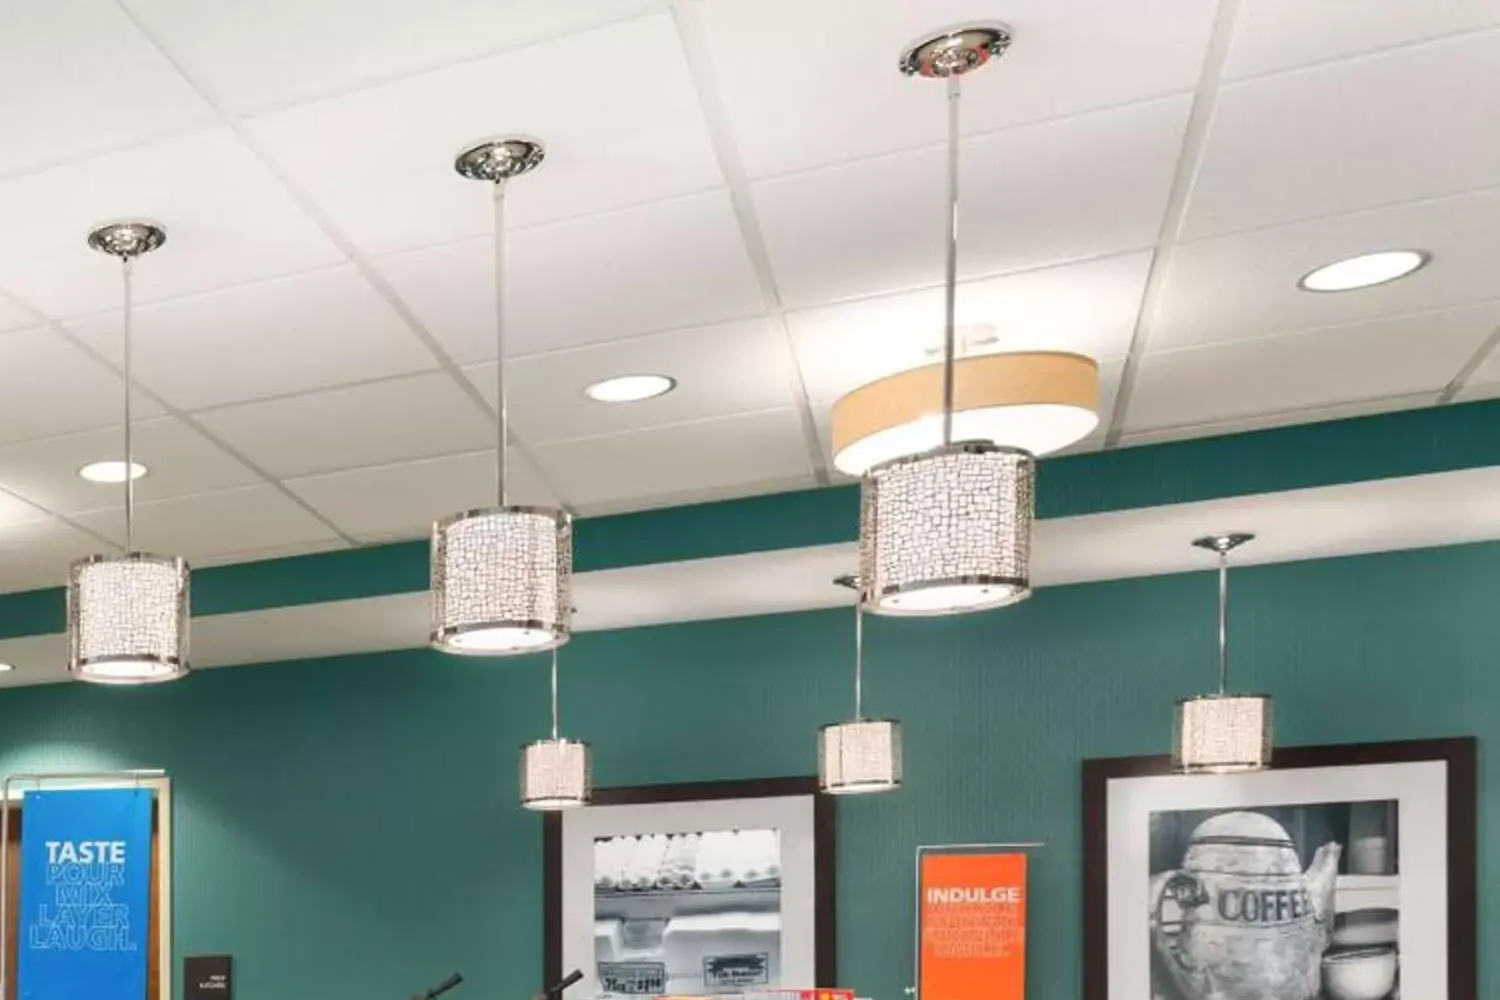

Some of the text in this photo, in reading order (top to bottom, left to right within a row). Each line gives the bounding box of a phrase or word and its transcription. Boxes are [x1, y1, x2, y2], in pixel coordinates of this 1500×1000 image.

[45, 841, 126, 863] TASTE
[46, 862, 125, 886] POUR
[55, 881, 112, 906] MIX
[928, 887, 1021, 905] INDULGE
[39, 903, 129, 928] LAYER
[29, 924, 138, 951] LAUGH.
